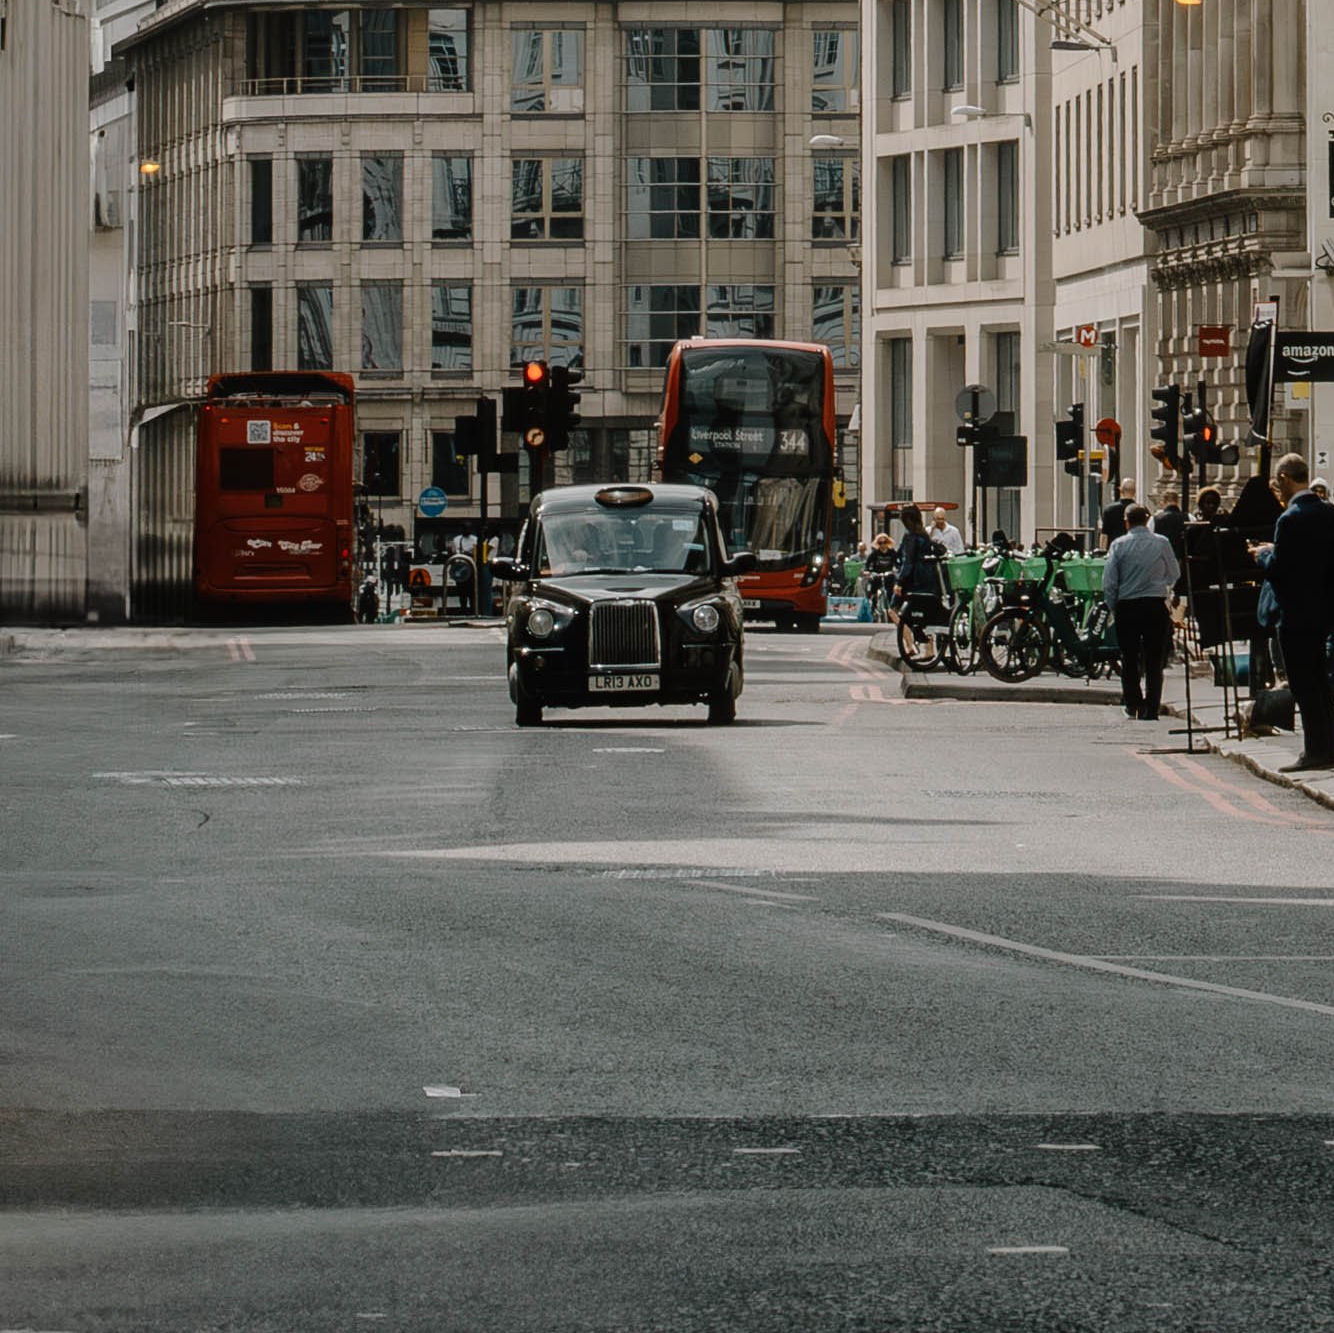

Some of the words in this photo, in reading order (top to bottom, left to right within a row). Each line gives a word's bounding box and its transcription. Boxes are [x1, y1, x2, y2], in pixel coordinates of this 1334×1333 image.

[1080, 328, 1096, 344] M
[691, 428, 733, 442] Liverpool
[735, 429, 764, 442] Street
[780, 431, 806, 451] 344
[595, 676, 624, 689] LR13
[627, 675, 652, 688] AXO
